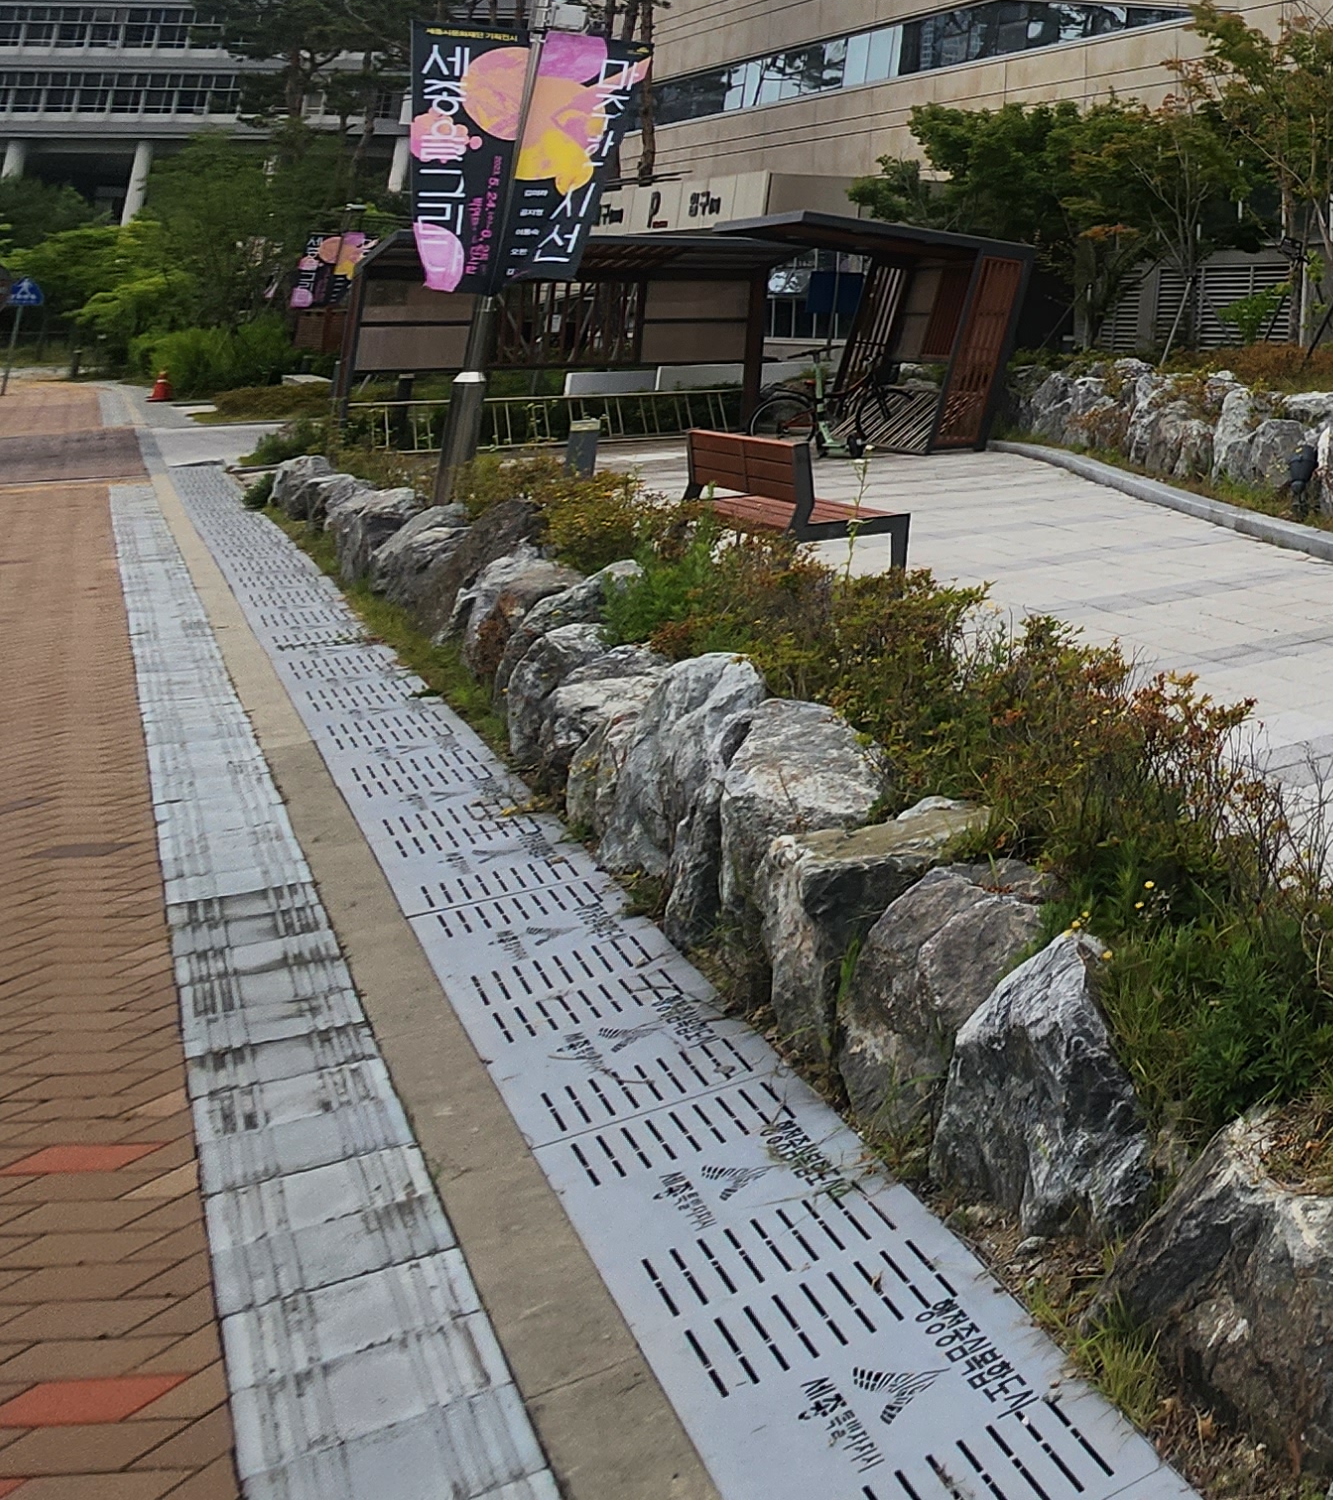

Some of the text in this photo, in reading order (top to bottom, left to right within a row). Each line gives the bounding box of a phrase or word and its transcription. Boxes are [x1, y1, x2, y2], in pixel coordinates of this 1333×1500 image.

[421, 44, 470, 162] 세종을
[532, 58, 641, 263] 마주한 시선
[646, 191, 662, 228] P
[688, 191, 711, 217] 입구
[915, 1297, 1040, 1420] 행정중심복합도시
[798, 1376, 885, 1474] 세종특별자치시
